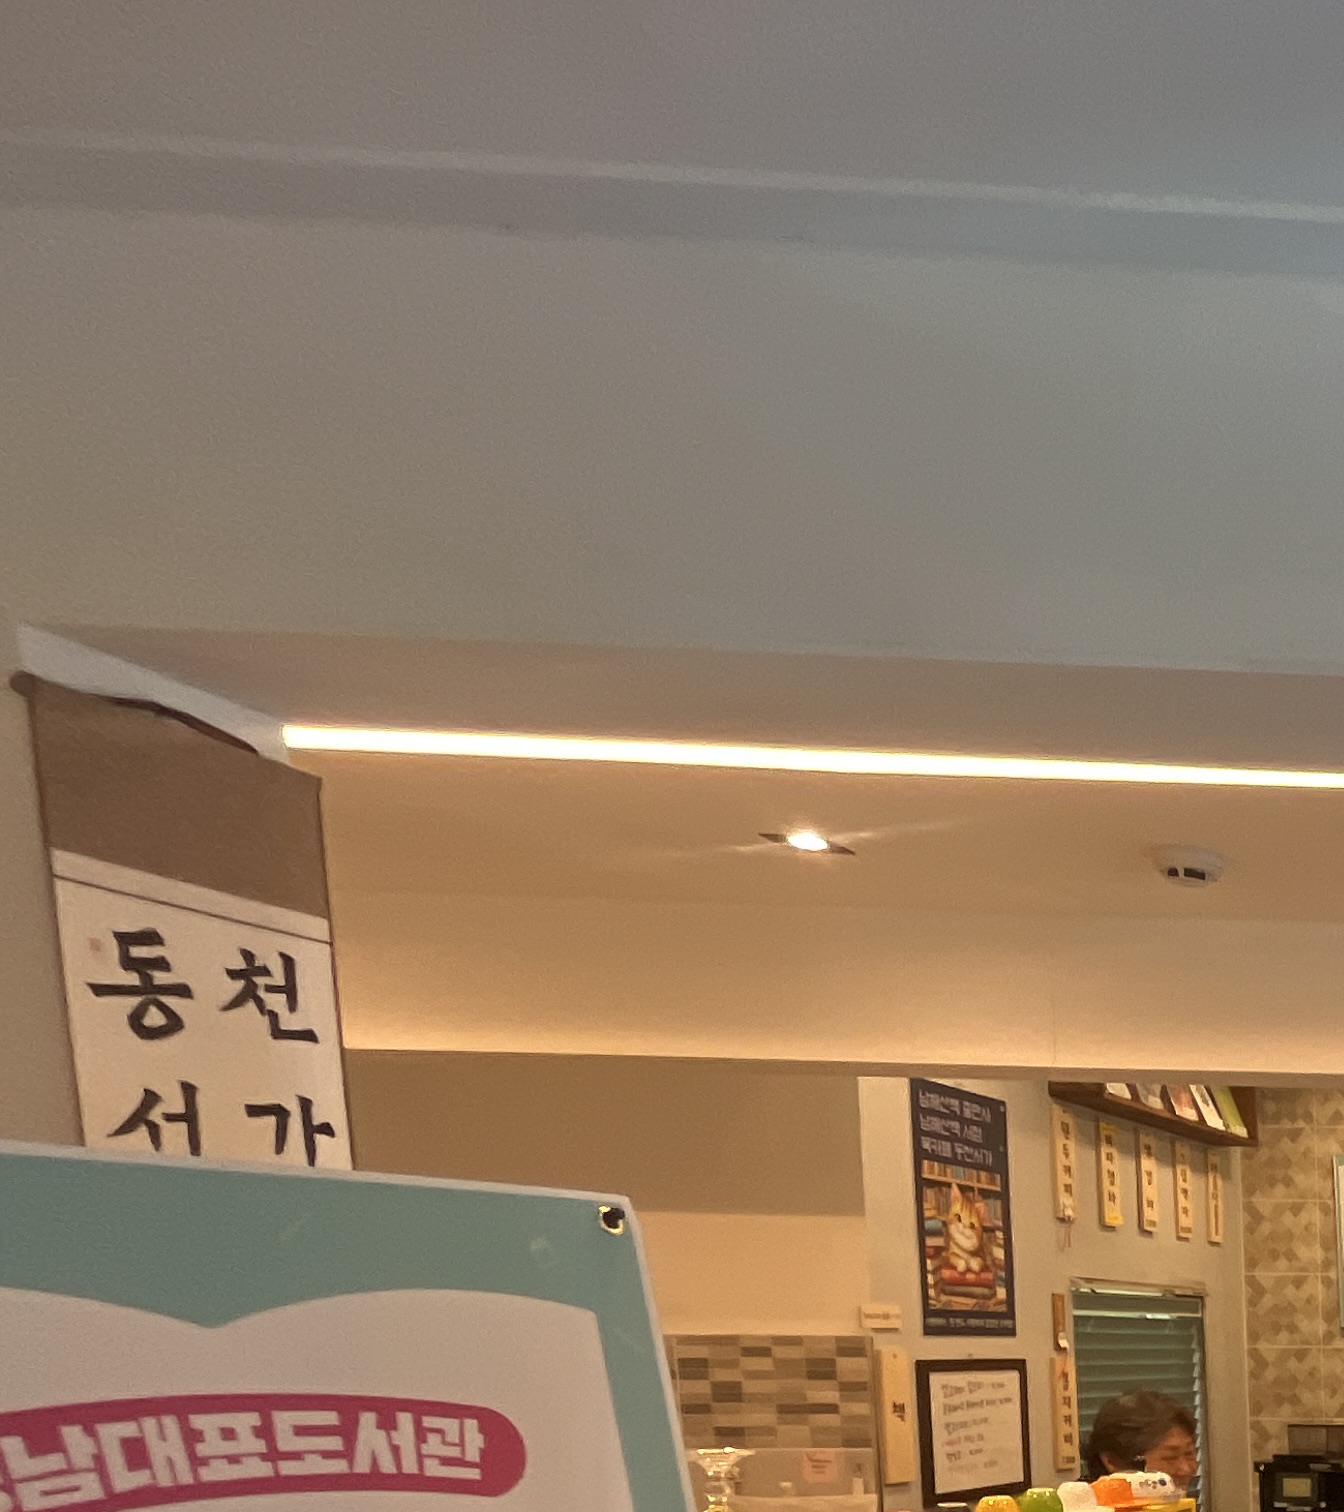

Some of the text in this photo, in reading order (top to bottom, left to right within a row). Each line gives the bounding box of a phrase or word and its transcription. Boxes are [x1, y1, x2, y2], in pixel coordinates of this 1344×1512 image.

[87, 927, 319, 1045] 동천
[106, 1079, 336, 1168] 서가
[0, 1409, 485, 1512] 남대표도서관
